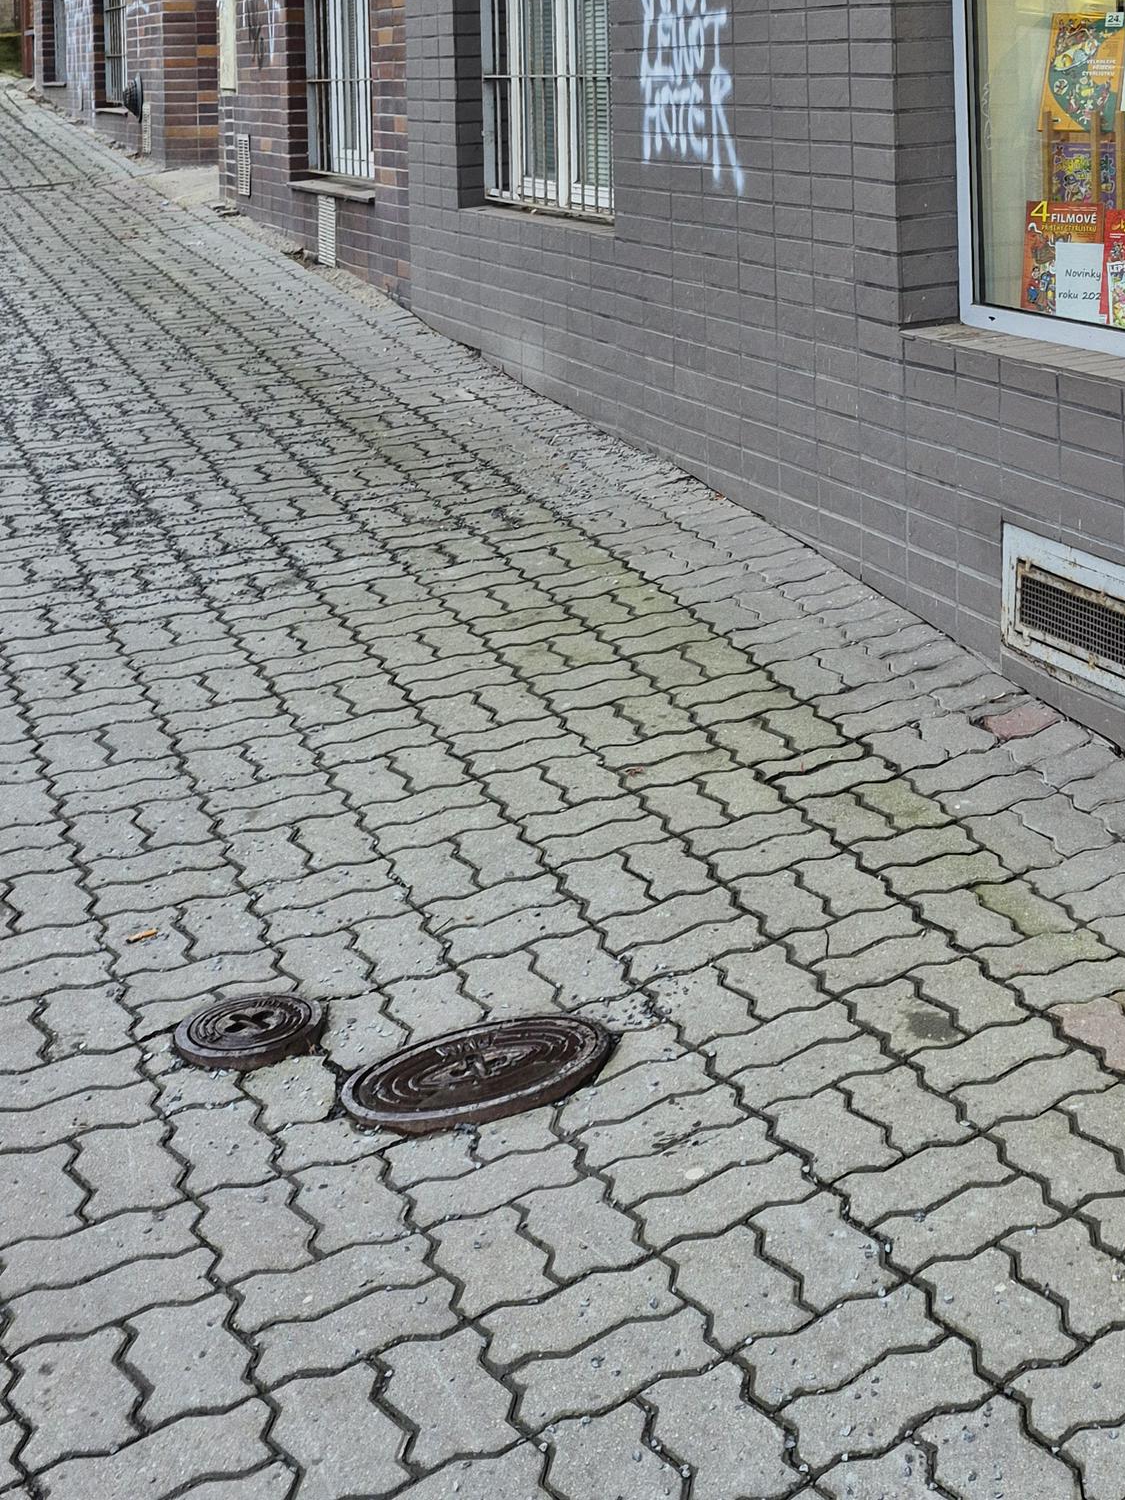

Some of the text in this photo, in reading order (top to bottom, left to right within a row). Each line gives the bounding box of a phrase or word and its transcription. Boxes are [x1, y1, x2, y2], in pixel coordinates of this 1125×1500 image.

[1030, 200, 1050, 222] 4
[1051, 212, 1097, 224] FILMOVÉ
[1064, 268, 1102, 281] Novinky
[1058, 290, 1102, 300] roku 202
